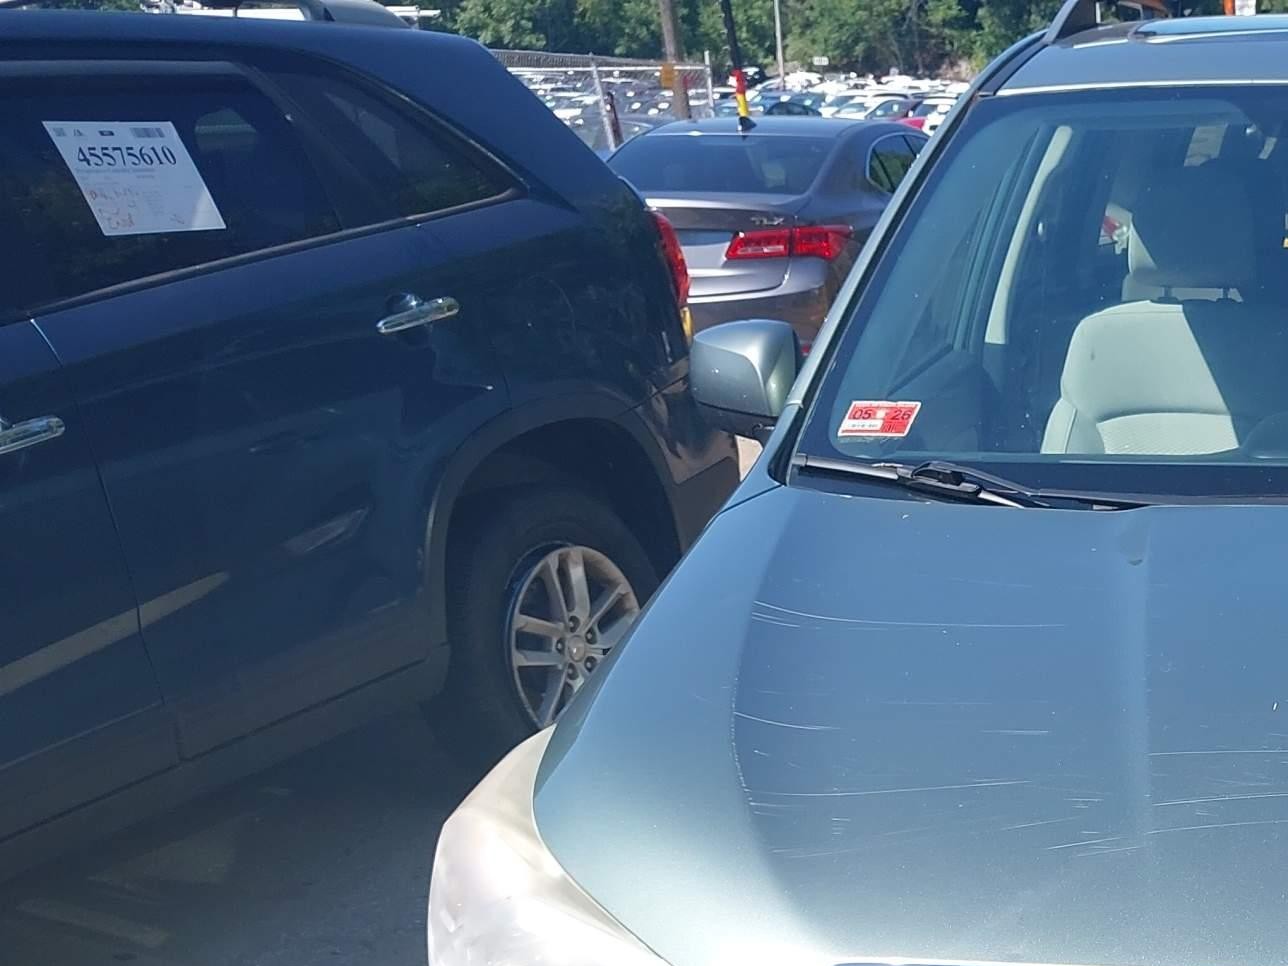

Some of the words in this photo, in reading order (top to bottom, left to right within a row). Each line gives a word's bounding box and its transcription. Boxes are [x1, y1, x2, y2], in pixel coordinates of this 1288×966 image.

[76, 144, 178, 168] 45575610
[851, 408, 874, 421] 05
[890, 408, 913, 421] 26
